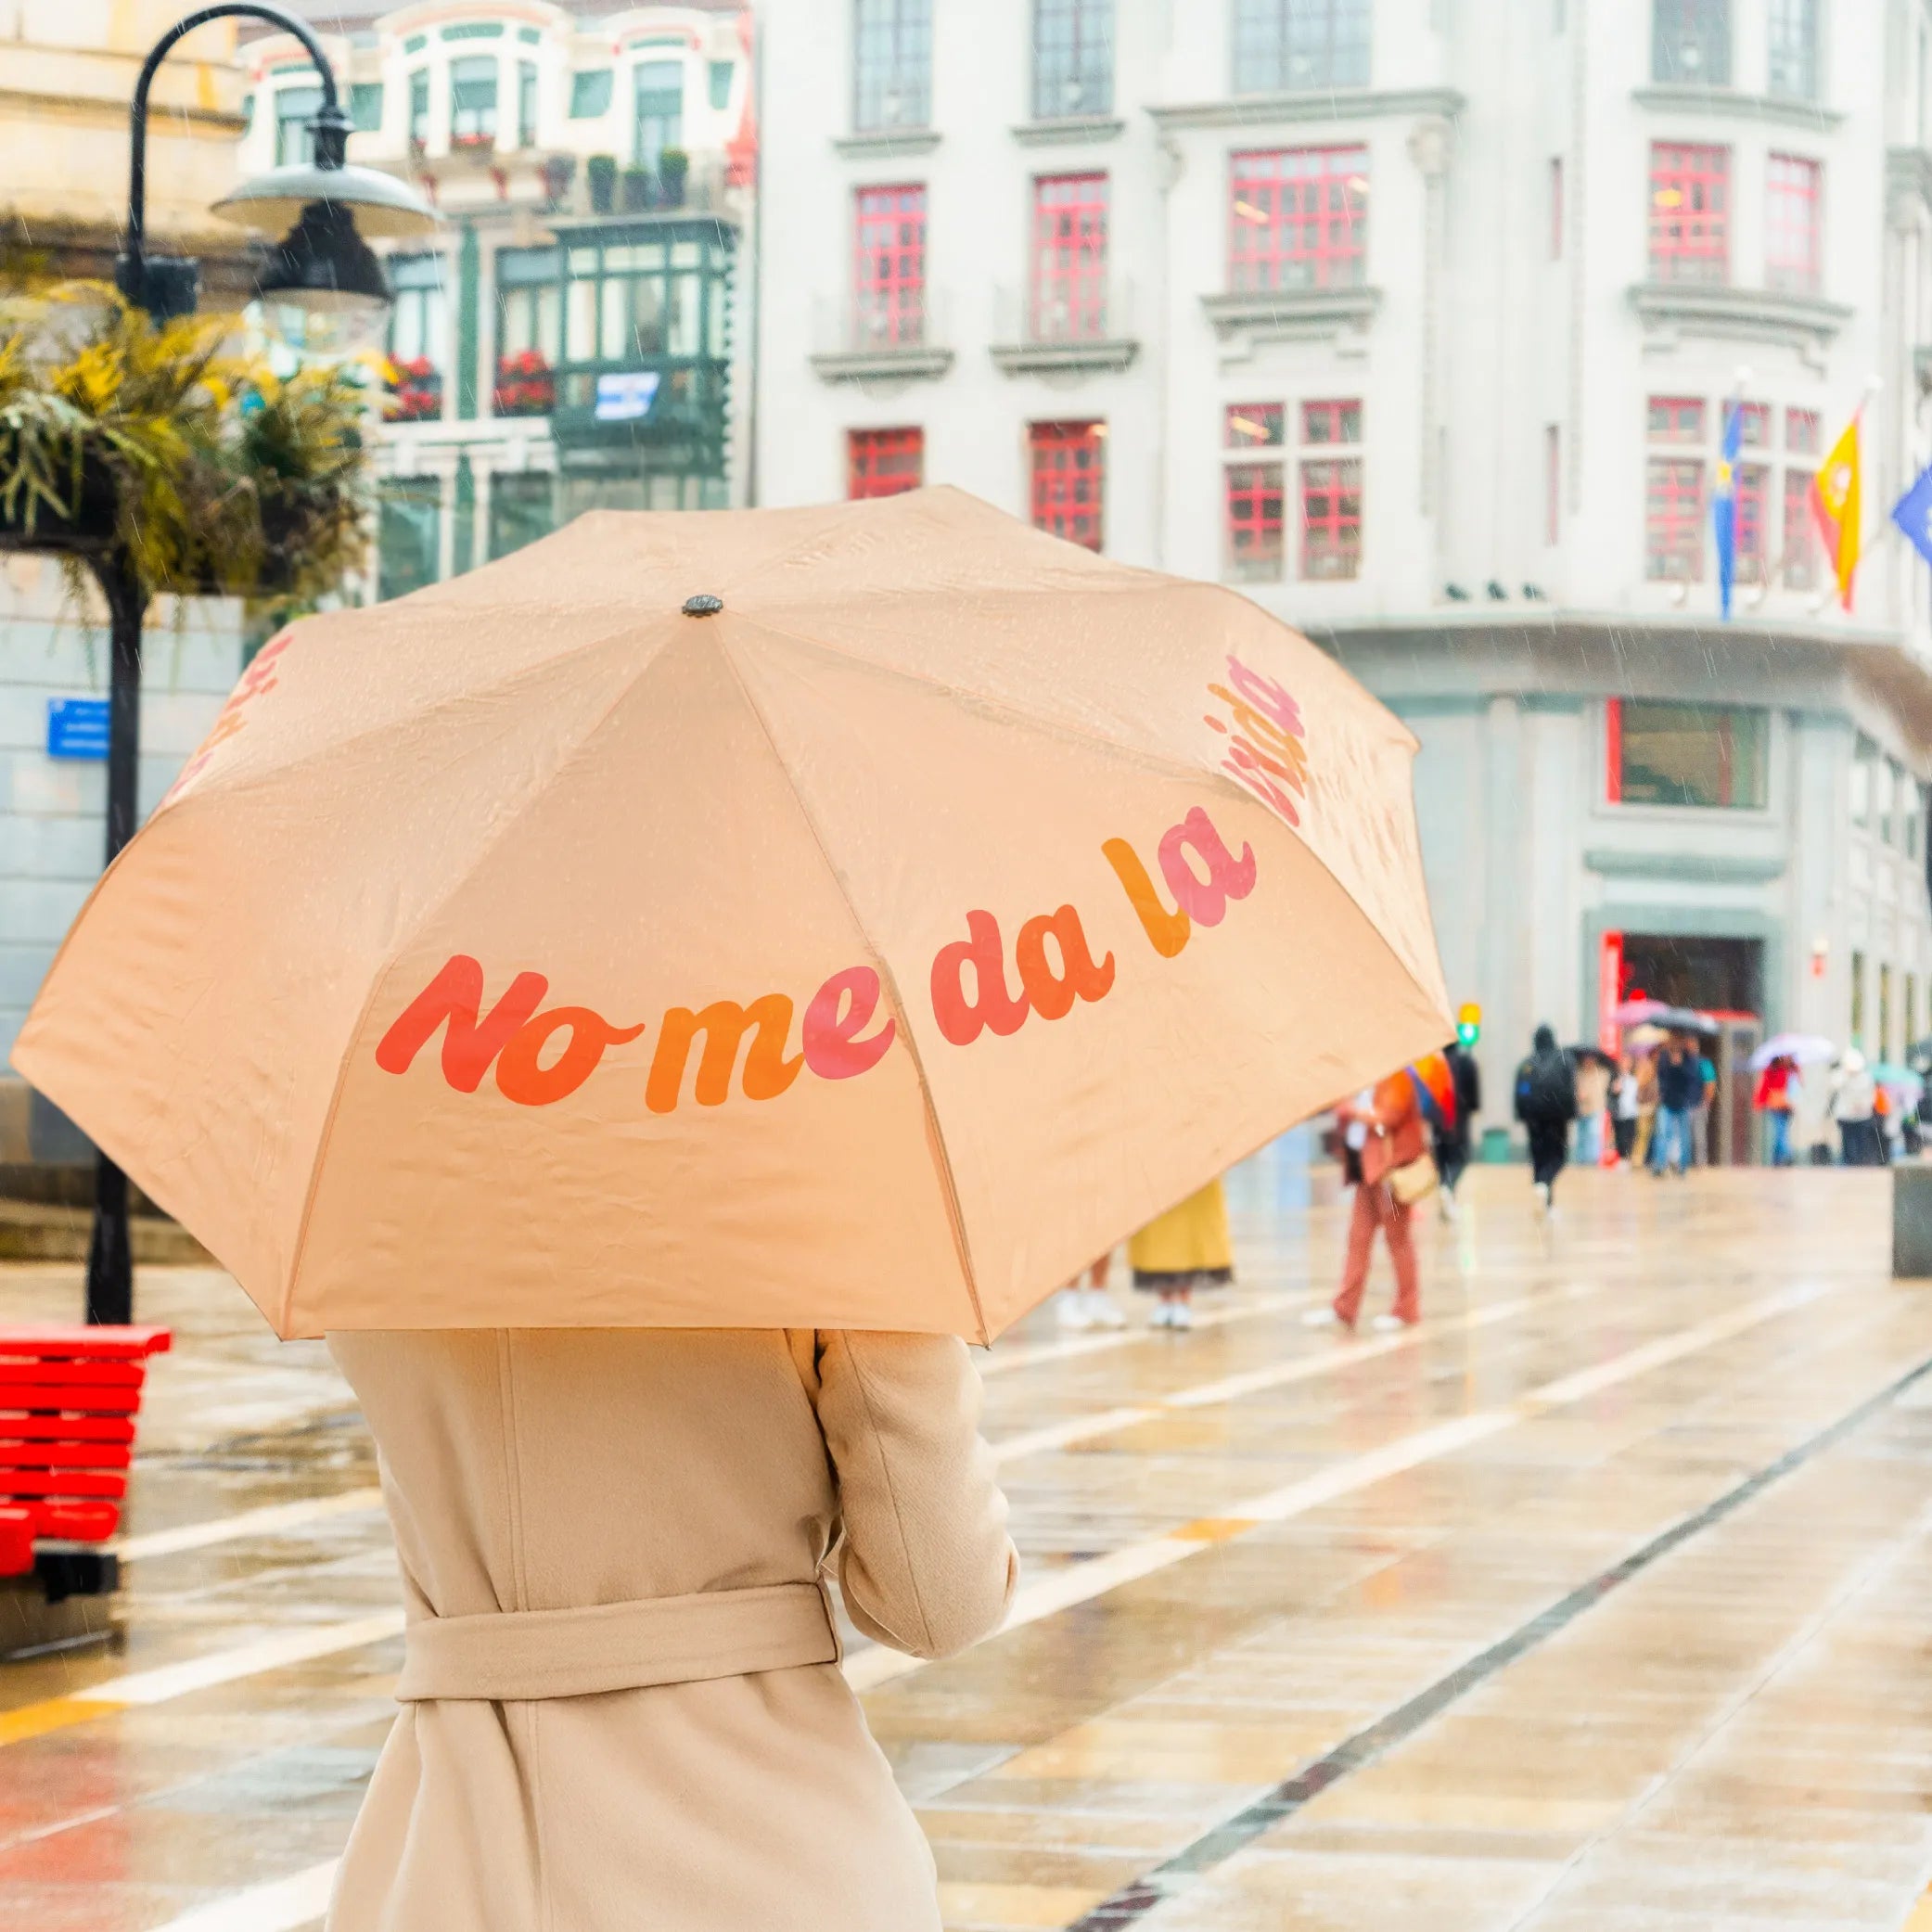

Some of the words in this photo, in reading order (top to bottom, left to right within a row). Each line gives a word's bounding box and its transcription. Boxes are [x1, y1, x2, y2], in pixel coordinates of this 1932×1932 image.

[375, 954, 646, 1107] No
[645, 966, 896, 1114] me
[930, 903, 1115, 1046] da
[1101, 806, 1257, 958] la
[1203, 655, 1307, 827] vida
